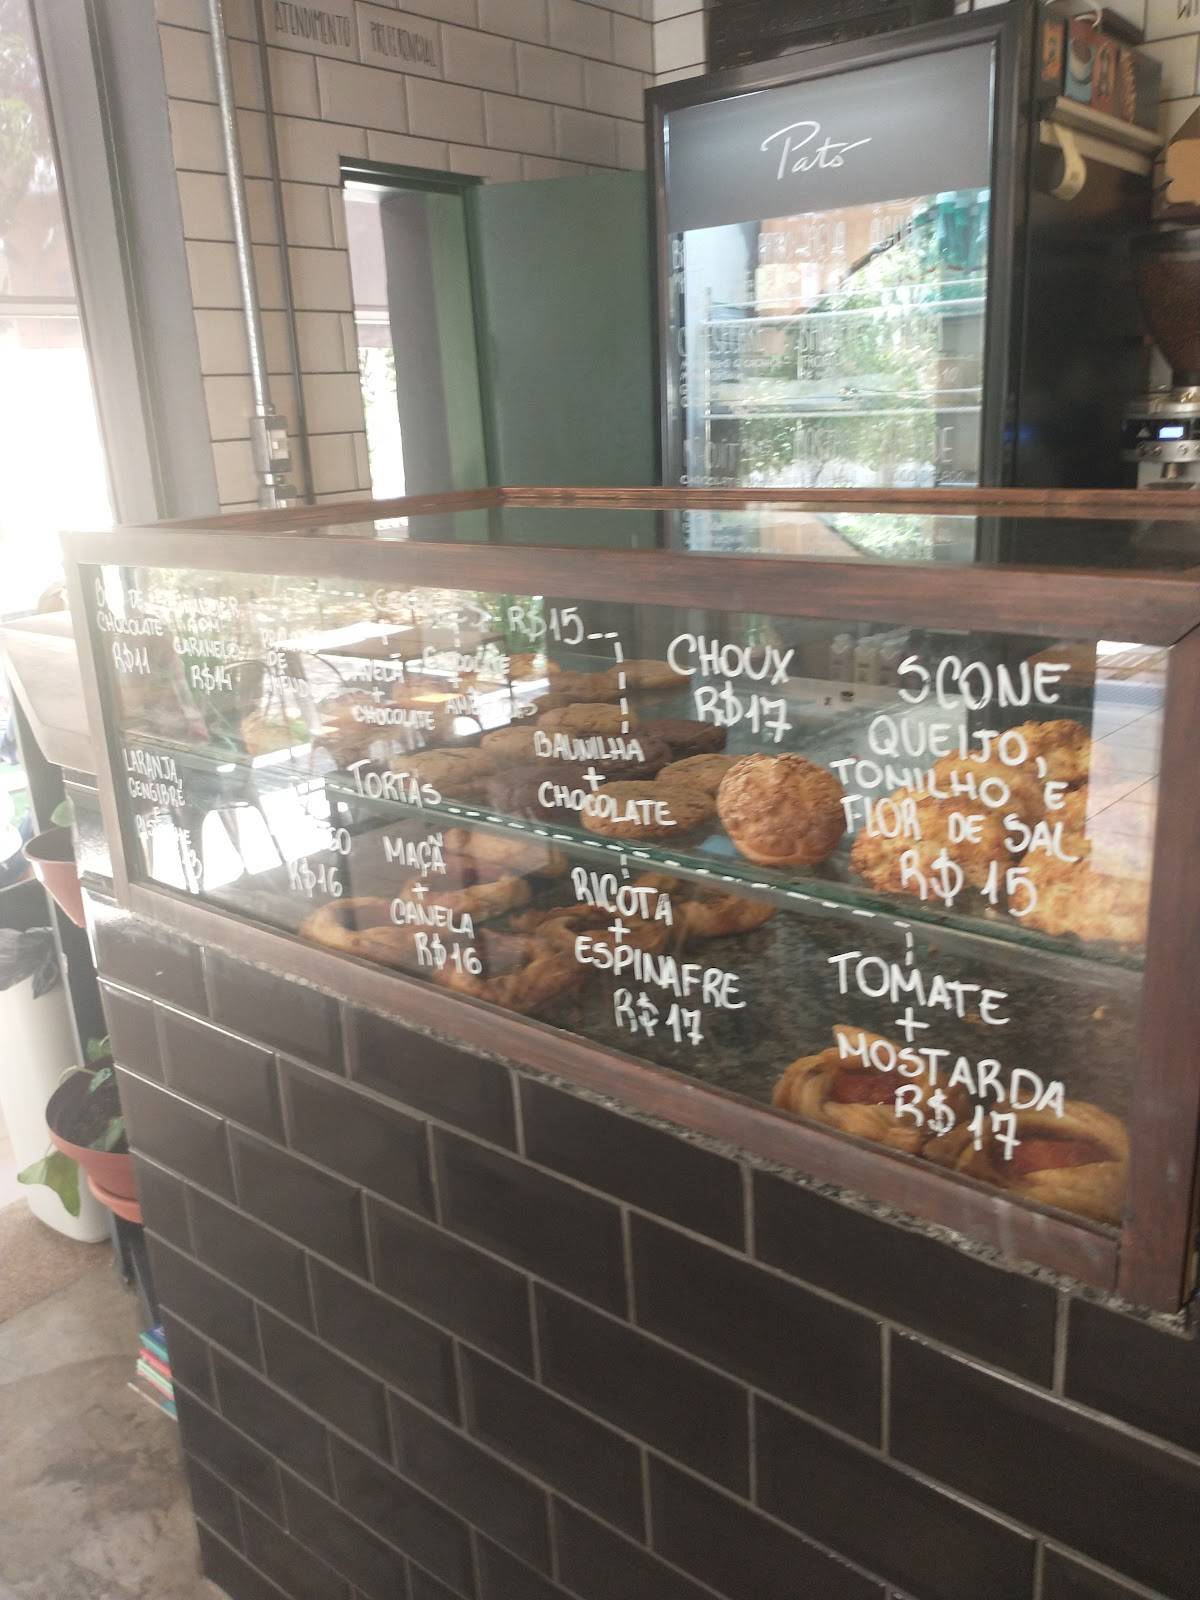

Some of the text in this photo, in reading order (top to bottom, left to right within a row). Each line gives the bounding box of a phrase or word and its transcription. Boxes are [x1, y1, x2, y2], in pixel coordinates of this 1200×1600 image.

[760, 120, 872, 180] Pato
[96, 611, 164, 636] CHOCOLATE
[667, 633, 795, 685] CHOUX
[897, 655, 1071, 710] SCONE
[352, 704, 436, 731] CHOCOLATE
[534, 730, 645, 763] BAUNILHA
[347, 759, 442, 808] TORTAS
[538, 781, 677, 827] CHOCOLATE
[828, 757, 1069, 810] TOMILHO E
[840, 794, 1082, 862] FLOR DE SAL
[382, 832, 446, 878] MAÇÃ
[390, 898, 475, 939] CANELA
[571, 867, 673, 926] RICOTA
[575, 936, 746, 1010] ESPINAFRE
[828, 951, 1010, 1026] TOMATE
[837, 1031, 1067, 1118] MOSTARDA
